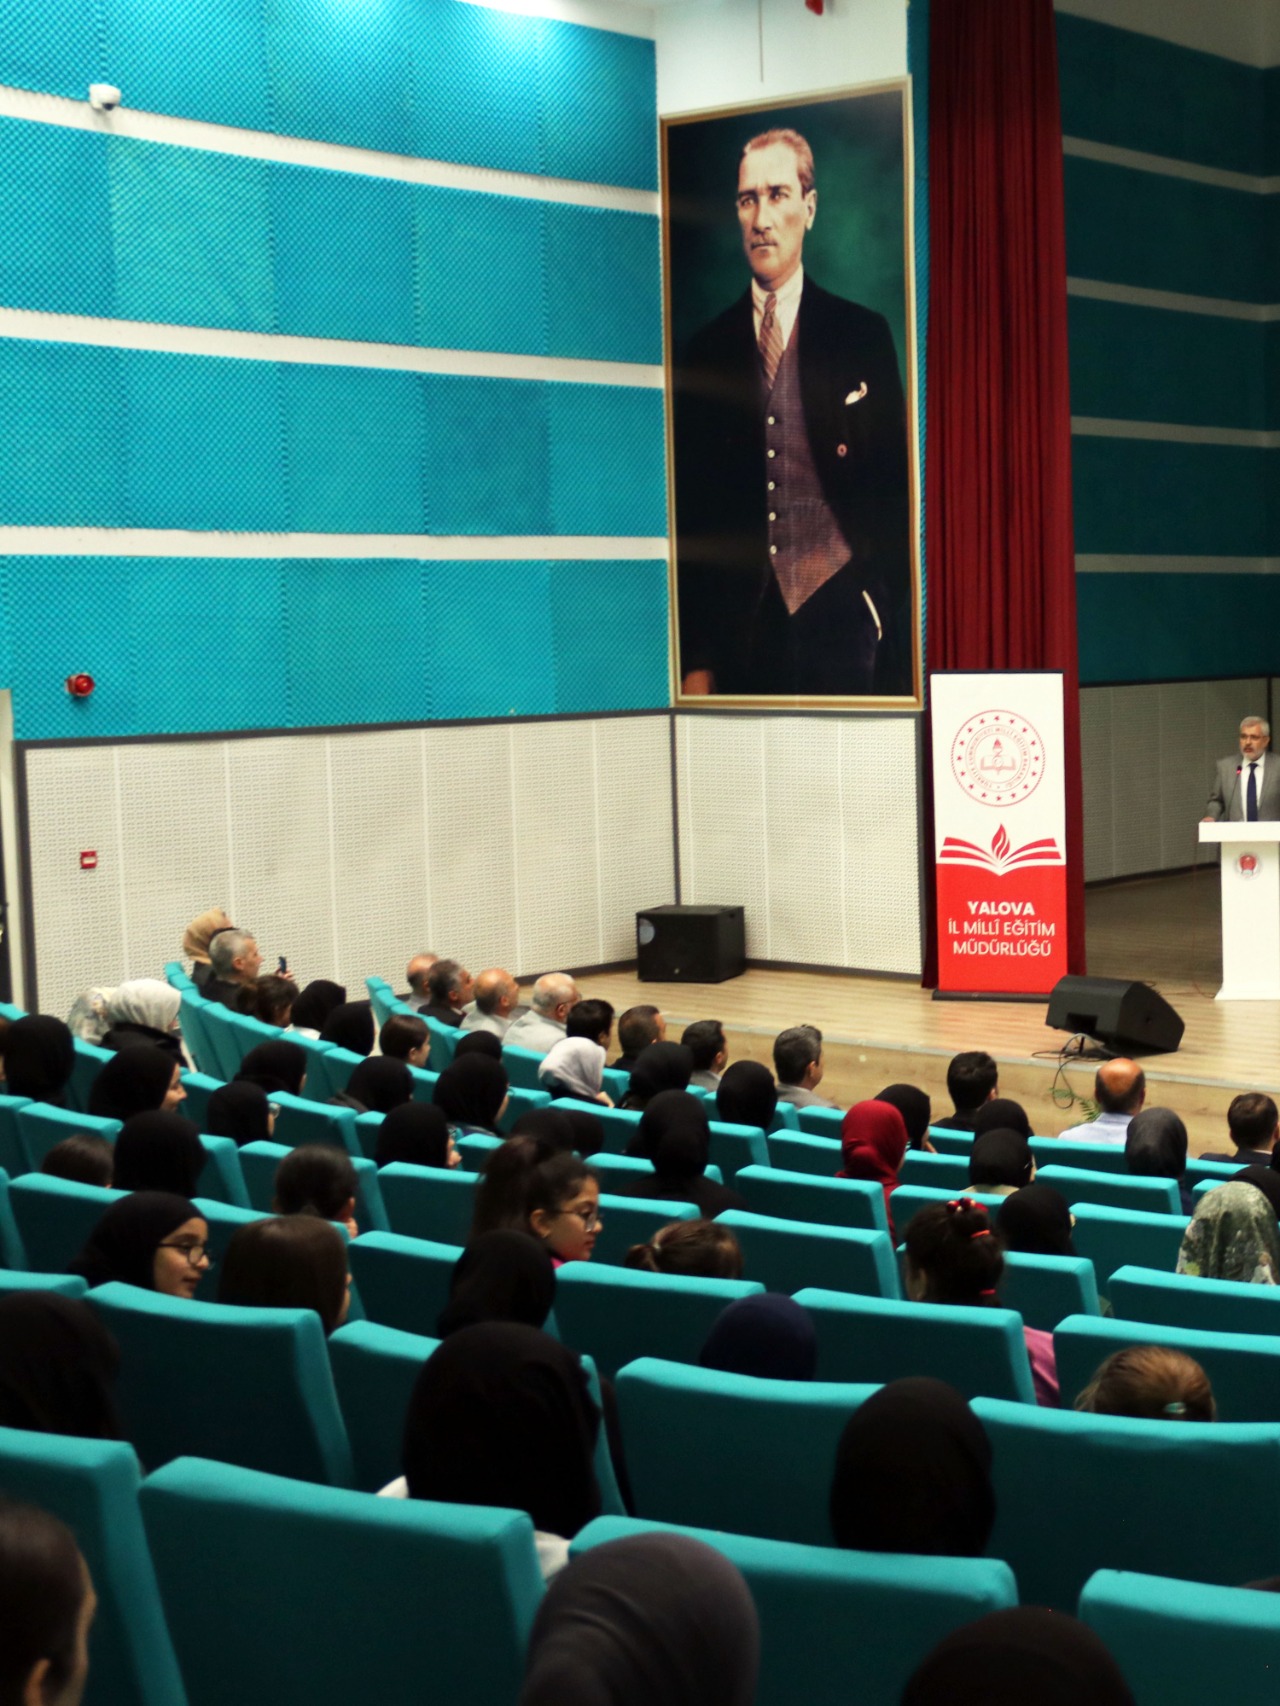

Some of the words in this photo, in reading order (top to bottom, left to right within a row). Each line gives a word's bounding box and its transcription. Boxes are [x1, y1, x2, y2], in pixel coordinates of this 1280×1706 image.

[967, 901, 1036, 916] YALOVA
[948, 918, 960, 935] İL
[963, 918, 1001, 935] MİLLÎ
[1003, 919, 1056, 937] EĞİTİM
[953, 938, 1052, 957] MÜDÜRLÜĞÜ
